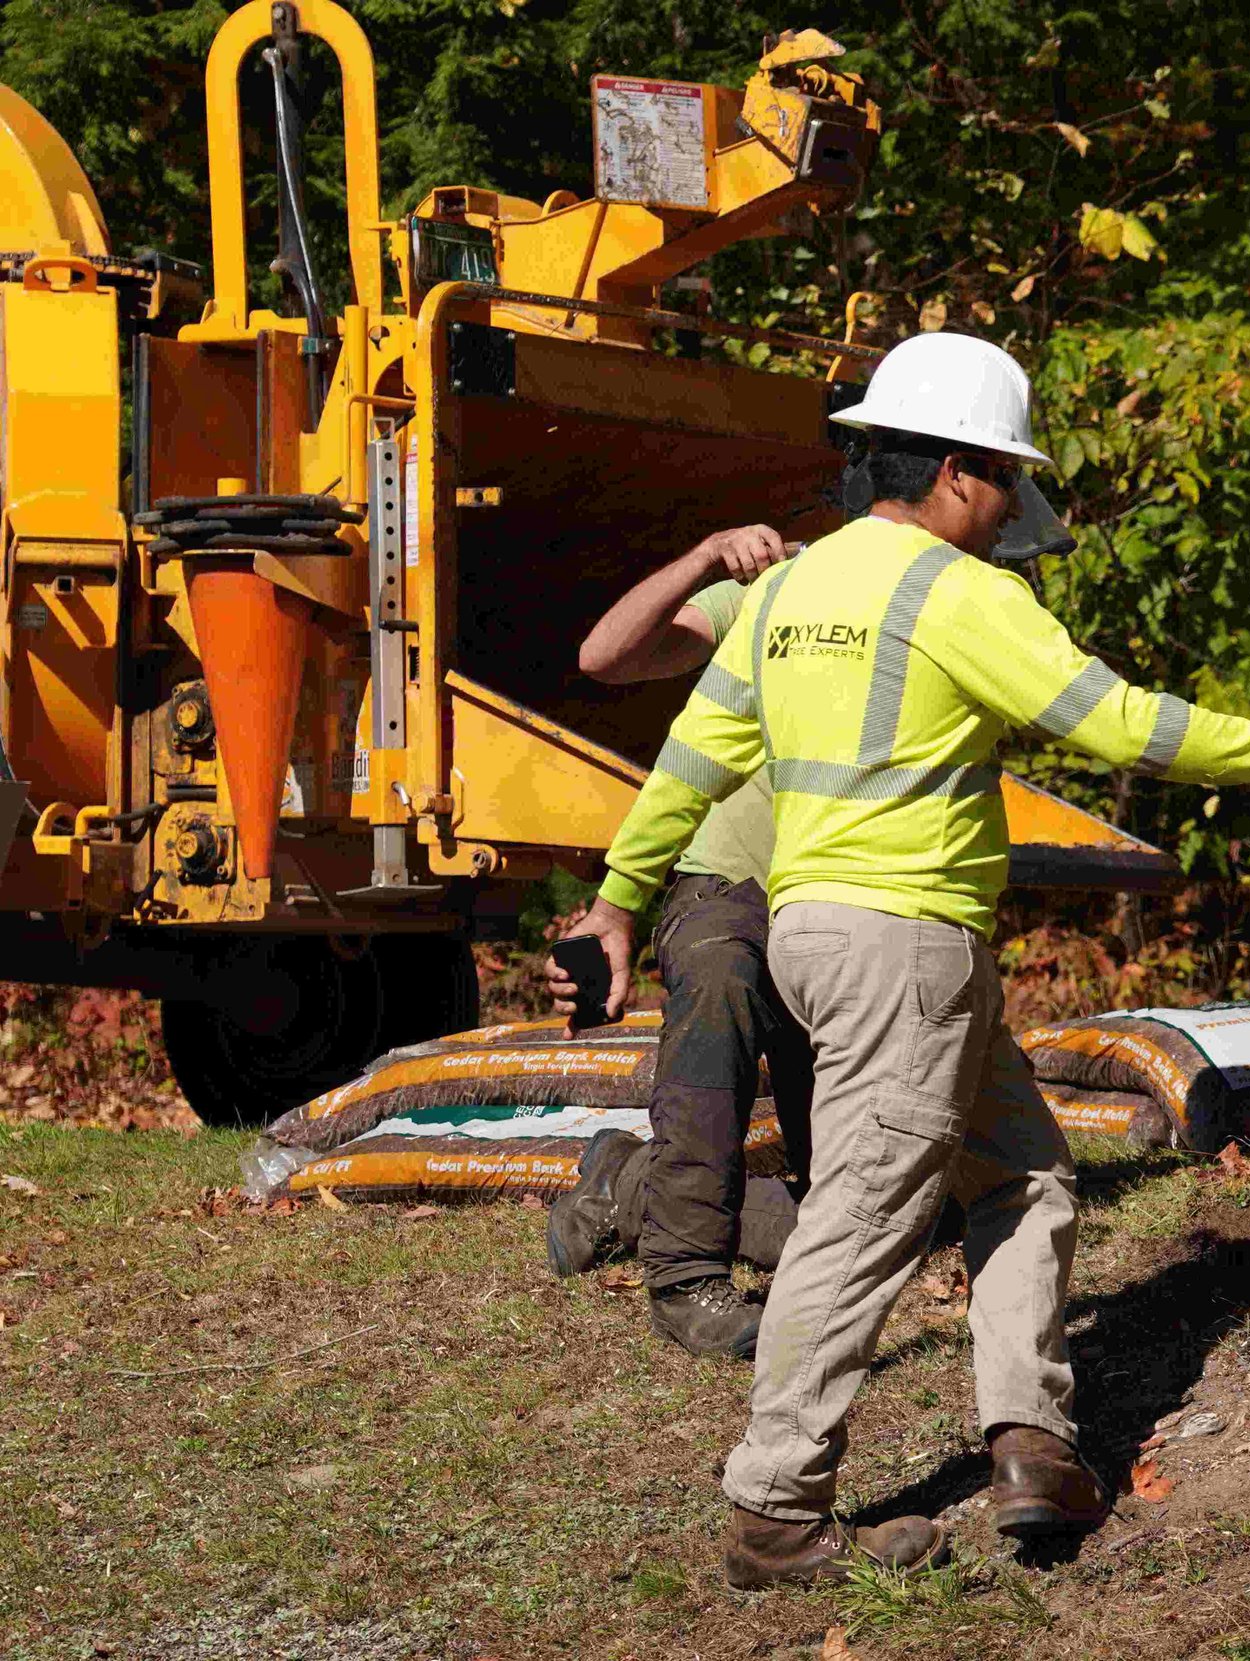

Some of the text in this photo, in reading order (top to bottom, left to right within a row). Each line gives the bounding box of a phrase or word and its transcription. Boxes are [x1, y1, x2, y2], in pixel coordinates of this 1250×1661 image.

[790, 624, 868, 647] XYLEM
[810, 646, 865, 660] EXPERTS
[331, 751, 370, 778] Bandi
[443, 1055, 485, 1067] Cedar
[592, 1052, 637, 1065] Mulch
[532, 1160, 563, 1175] Bark
